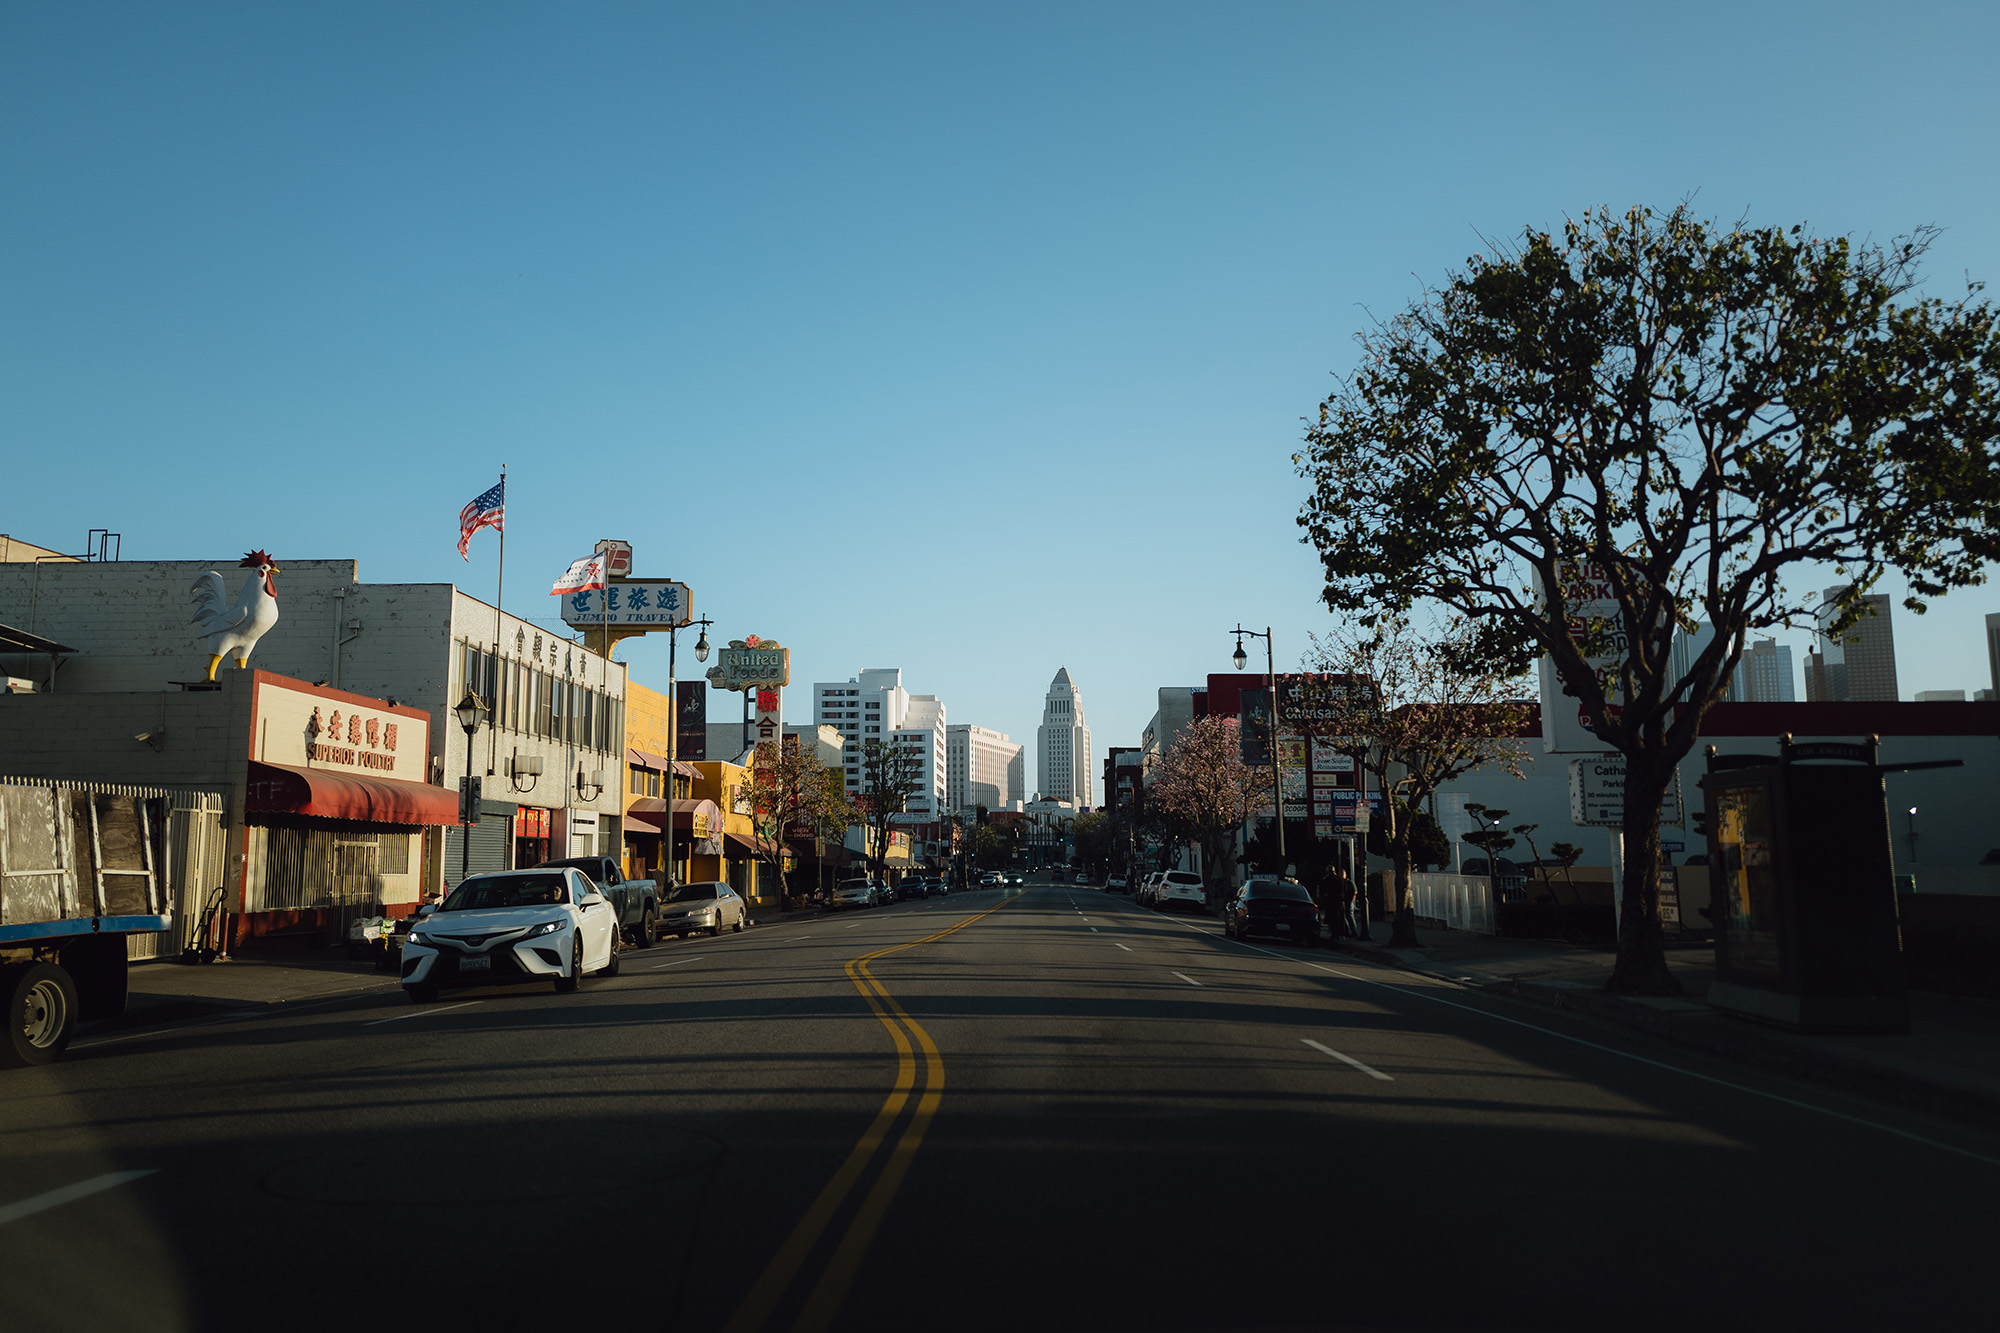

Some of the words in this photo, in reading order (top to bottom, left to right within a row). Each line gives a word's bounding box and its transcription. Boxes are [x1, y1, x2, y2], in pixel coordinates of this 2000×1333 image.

[574, 613, 617, 622] JUMBO
[626, 613, 674, 622] TRAVEL
[727, 654, 779, 666] United
[730, 667, 779, 679] Foods
[308, 742, 355, 765] SUPERIOR
[358, 751, 395, 771] POULTRY
[1798, 748, 1815, 756] LOS
[1820, 747, 1859, 757] ANGELES
[1332, 758, 1352, 766] Seafood
[1594, 765, 1627, 776] Catha
[1603, 780, 1625, 788] Parki
[1333, 791, 1355, 800] PUBLIC
[1356, 791, 1382, 800] PAKING
